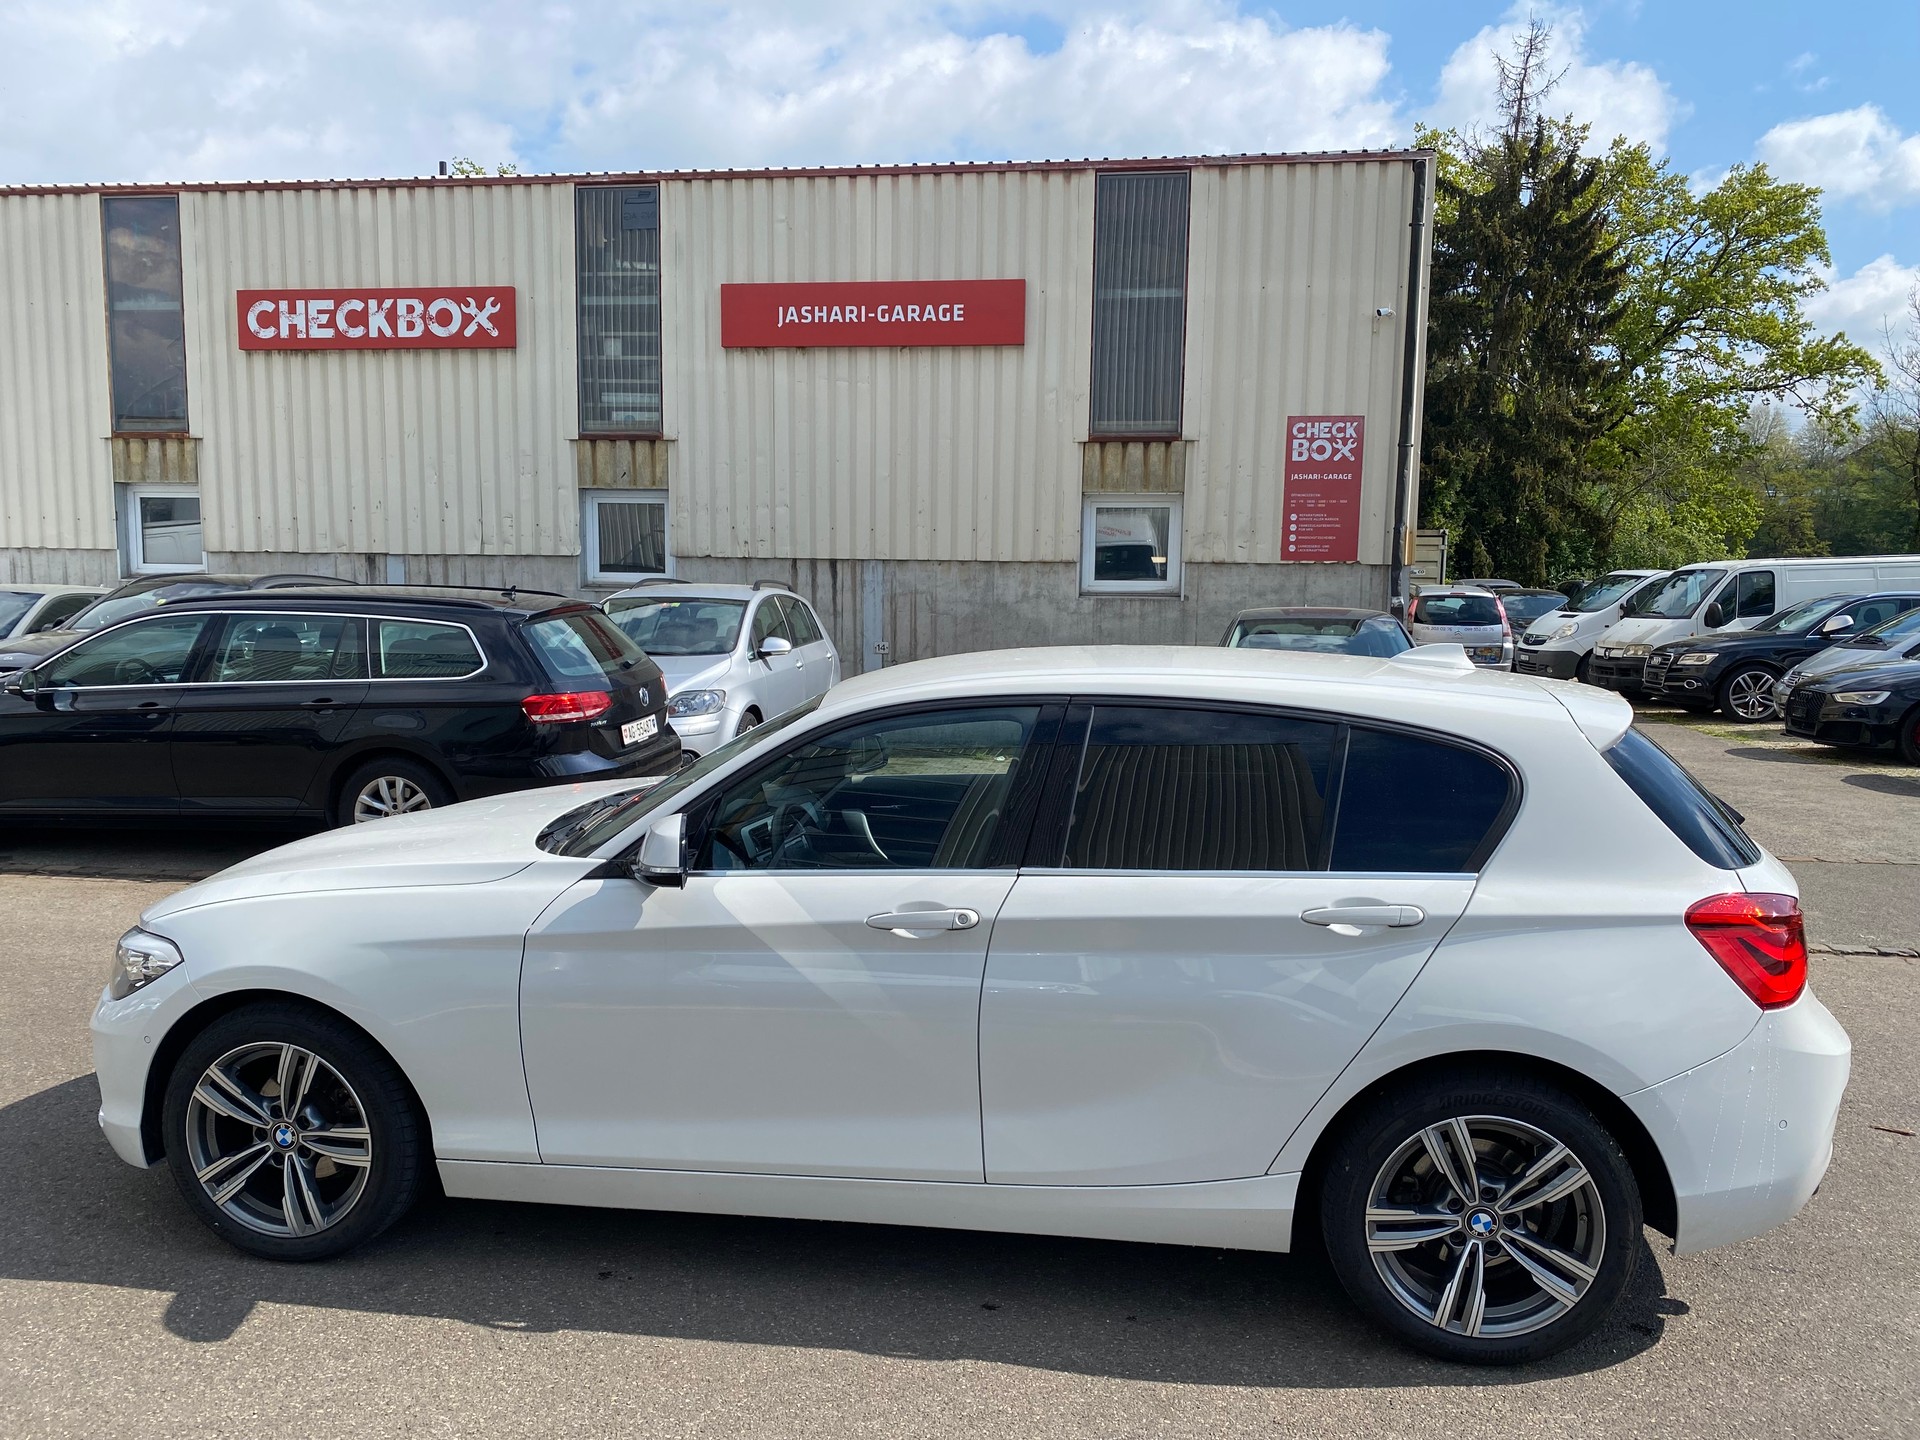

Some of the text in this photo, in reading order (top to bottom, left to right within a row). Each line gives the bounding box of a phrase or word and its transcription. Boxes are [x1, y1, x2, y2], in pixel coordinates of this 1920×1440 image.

[247, 296, 501, 339] CHECKBOX
[777, 303, 965, 328] JASHARI-GARAGE
[1292, 421, 1359, 439] CHECK
[1291, 438, 1358, 462] BOX
[1290, 473, 1353, 481] JASHARI-GARAGE
